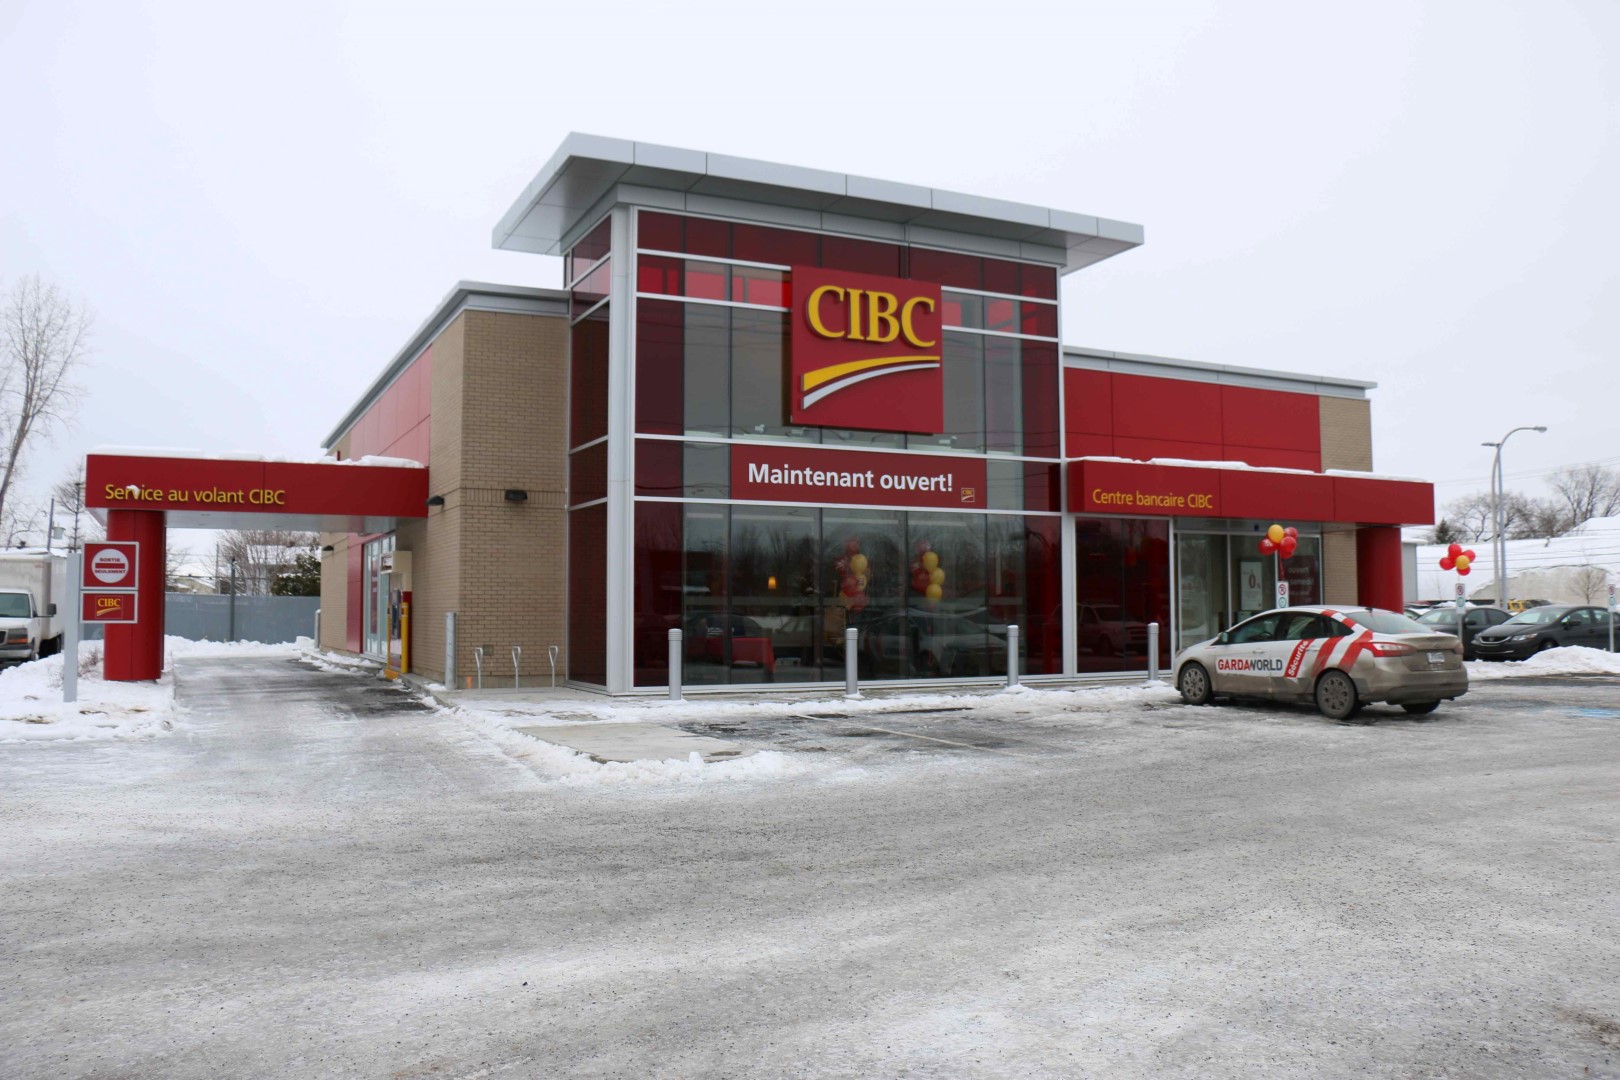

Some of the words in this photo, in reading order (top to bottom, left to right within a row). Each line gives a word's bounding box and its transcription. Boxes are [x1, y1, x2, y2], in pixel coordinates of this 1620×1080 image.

[807, 284, 936, 348] CIBC
[748, 463, 874, 489] Maintenant
[879, 473, 953, 492] ouvert!
[167, 491, 189, 502] au
[193, 487, 245, 504] volant
[249, 489, 285, 505] CIBC
[1092, 489, 1133, 505] Centre
[1136, 490, 1185, 507] bancaire
[1187, 494, 1213, 509] CIBC
[97, 598, 121, 607] CIBC
[1217, 659, 1283, 671] GARDAWORLD
